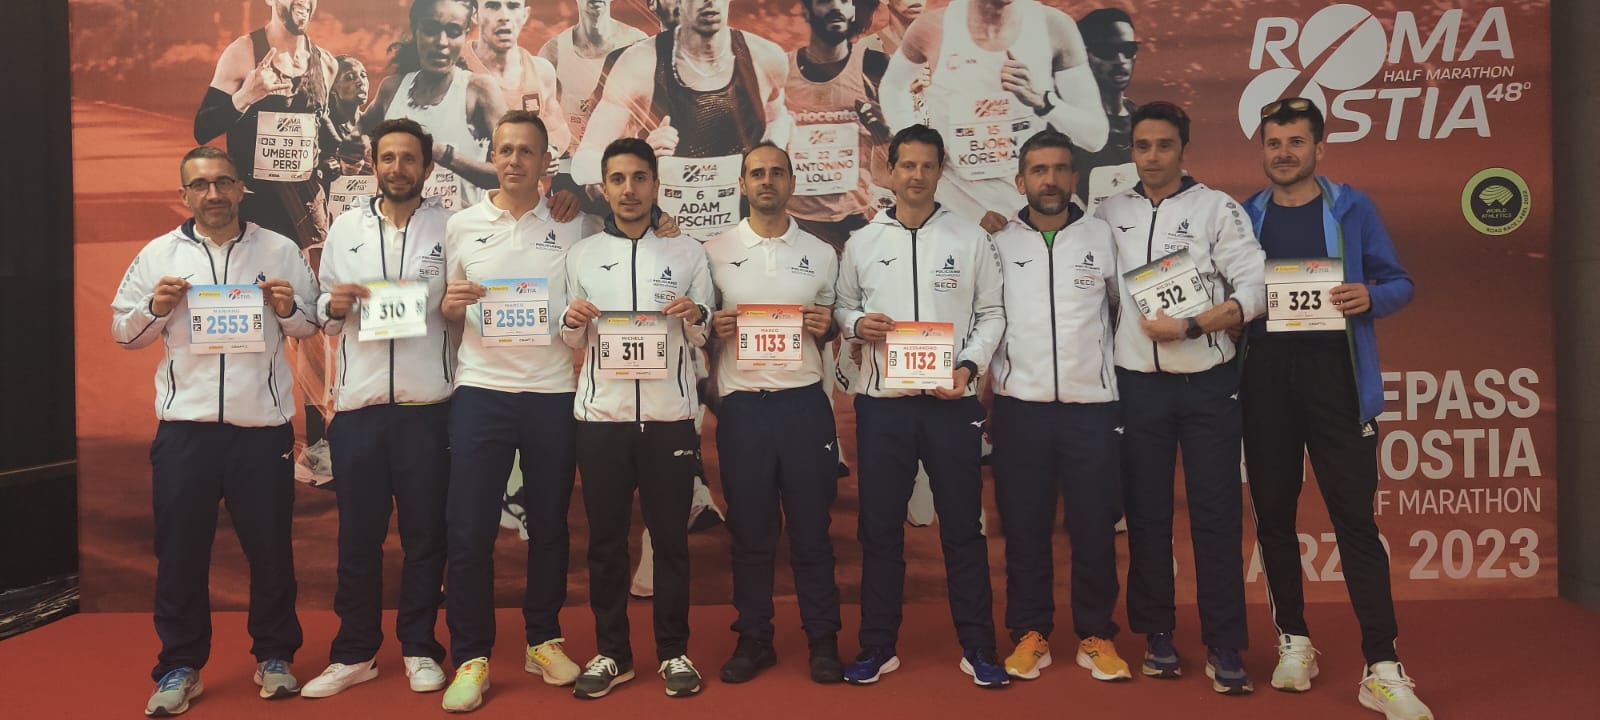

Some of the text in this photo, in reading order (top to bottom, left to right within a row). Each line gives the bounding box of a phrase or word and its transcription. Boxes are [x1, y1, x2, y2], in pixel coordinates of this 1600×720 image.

[1249, 4, 1515, 90] ROMA
[1384, 66, 1515, 82] HALF MARATHON
[283, 138, 293, 146] 39
[262, 148, 309, 159] UMBERTO
[272, 159, 301, 169] PERSI
[796, 160, 854, 171] ANTONINO
[806, 172, 842, 182] LOLLO
[696, 190, 704, 200] 6
[679, 202, 720, 214] ADAM
[674, 212, 731, 227] IPSCHITZ
[1157, 285, 1187, 309] 312
[1289, 290, 1322, 310] 323
[379, 302, 405, 320] 310
[496, 308, 536, 328] 2555
[206, 314, 249, 334] 2553
[622, 342, 644, 360] 311
[754, 334, 786, 352] 1133
[904, 351, 937, 370] 1132
[1379, 428, 1541, 481] OSTIA
[1399, 487, 1541, 515] MARATHON
[1409, 528, 1540, 580] 2023
